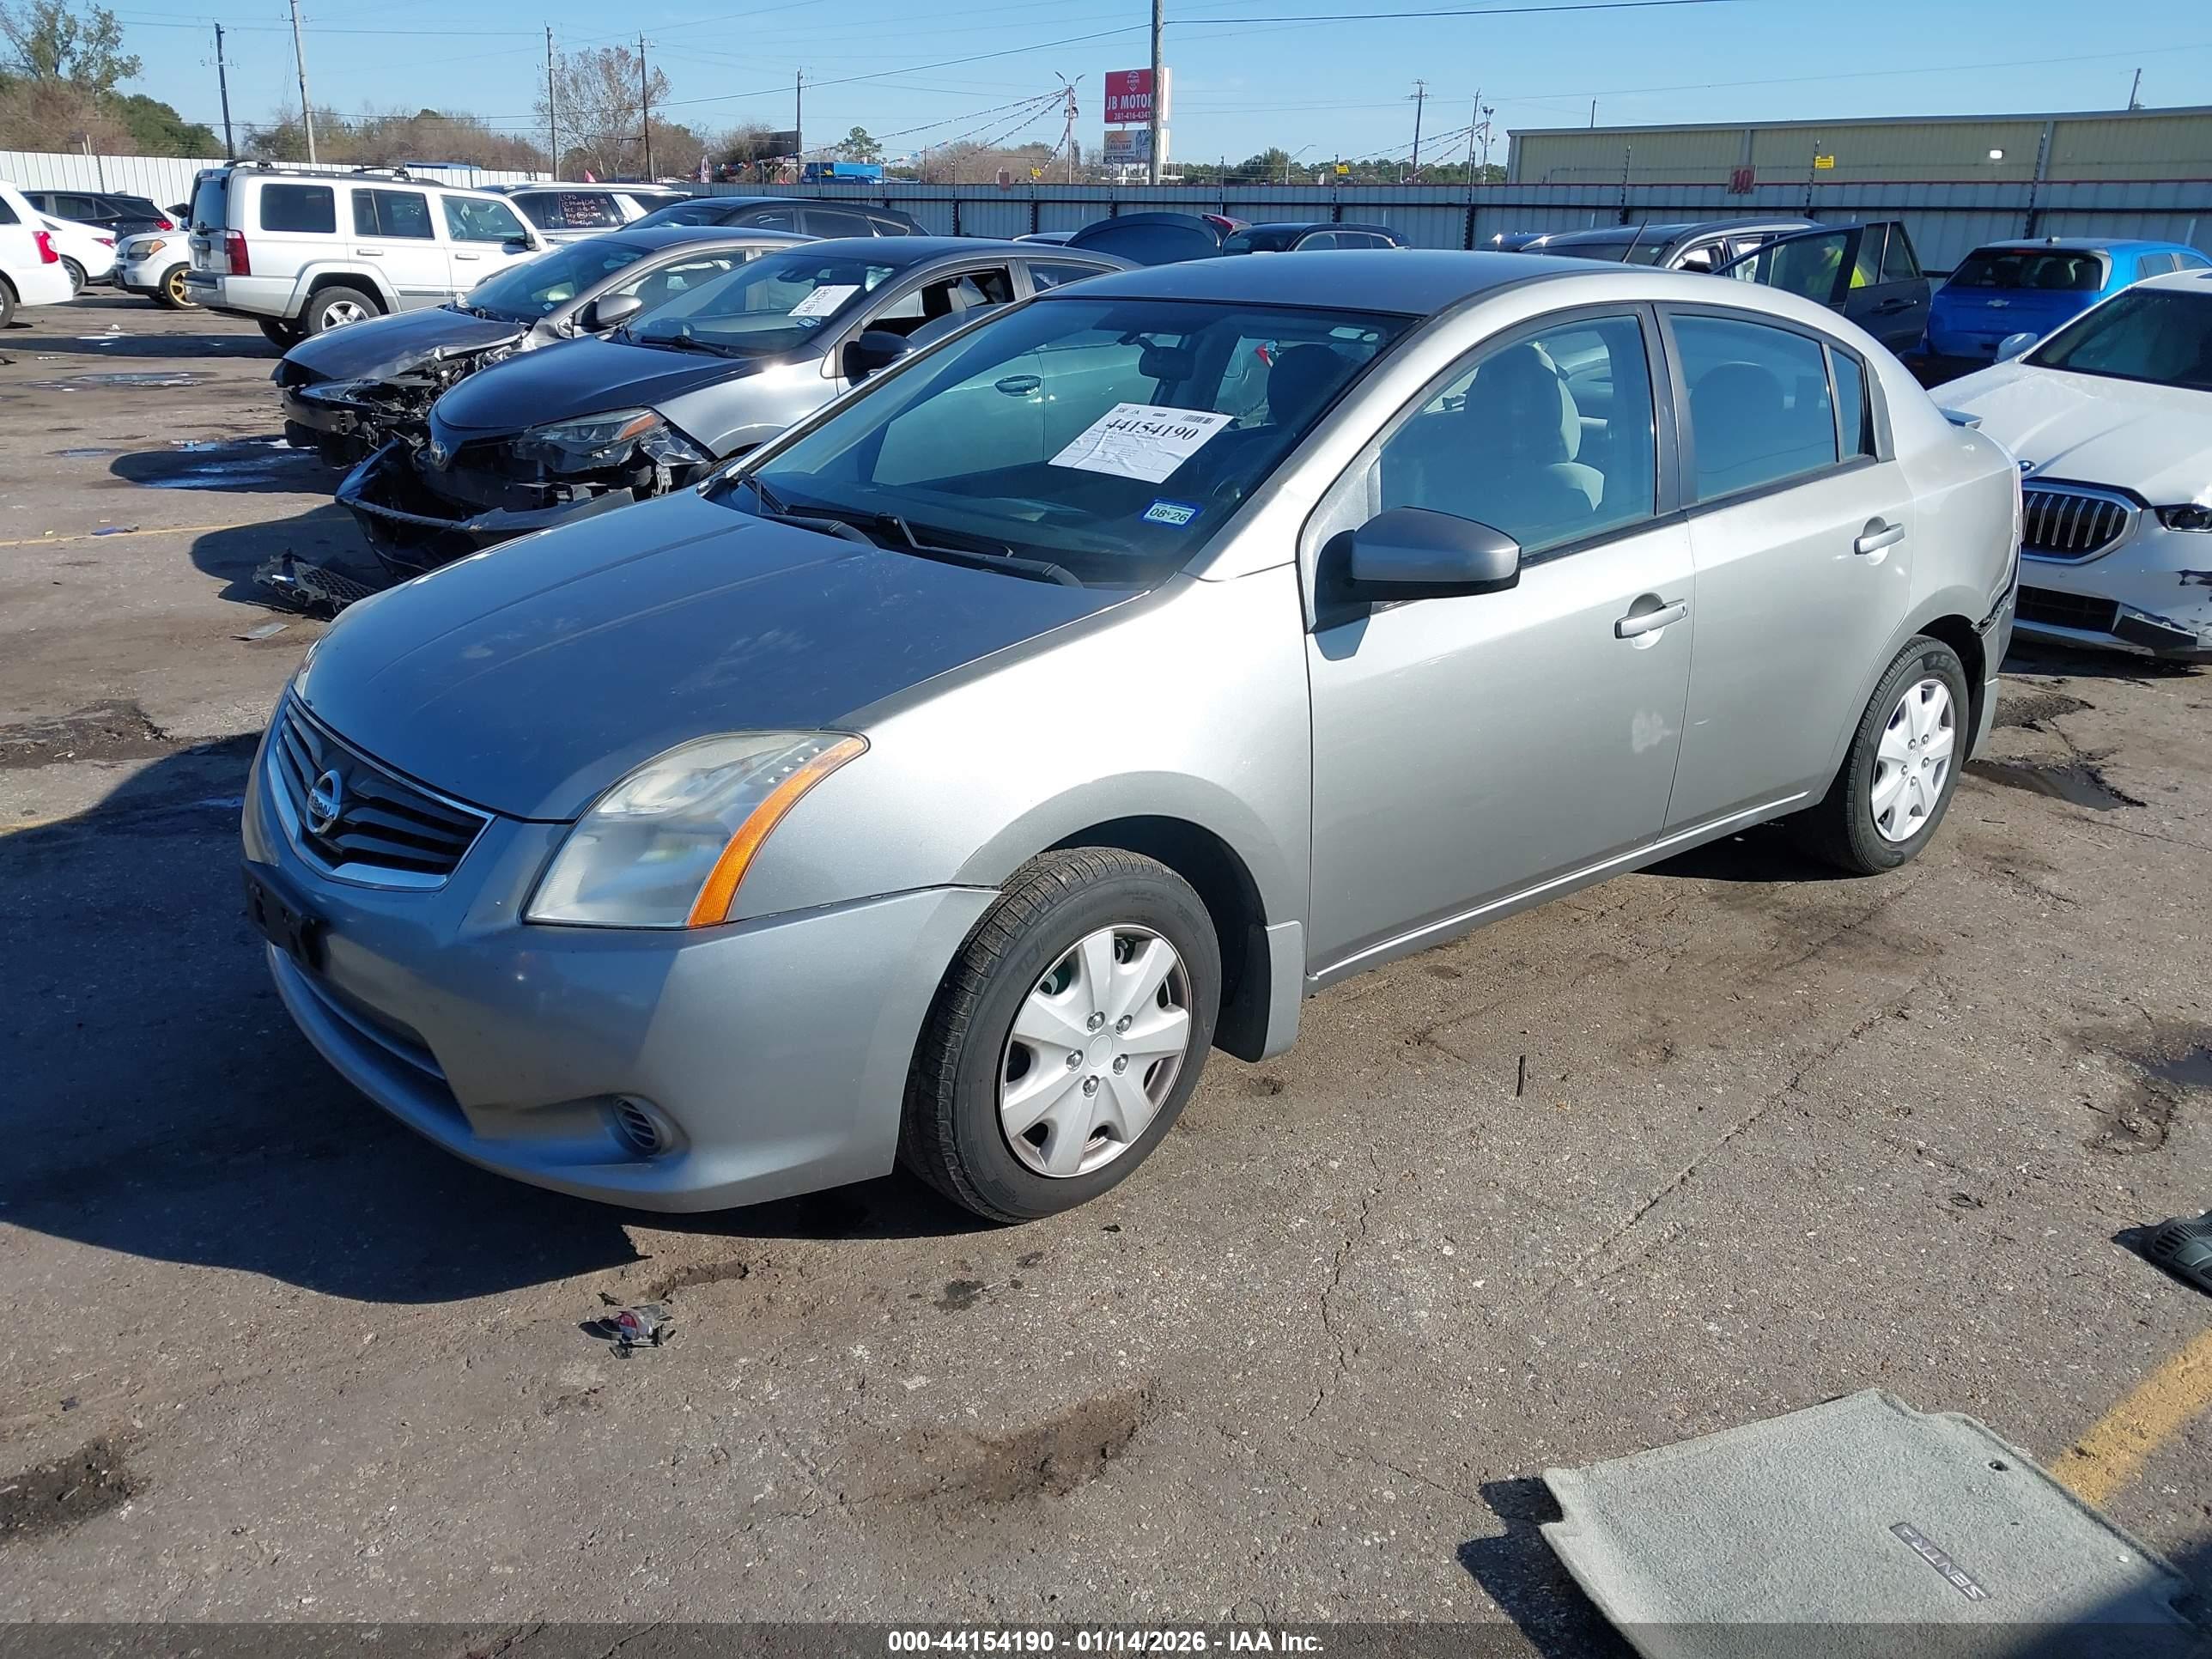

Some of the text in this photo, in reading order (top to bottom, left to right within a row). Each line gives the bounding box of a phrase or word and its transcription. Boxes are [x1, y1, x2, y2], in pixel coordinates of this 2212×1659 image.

[1107, 95, 1118, 110] JB
[1106, 418, 1199, 441] 44154190
[1150, 508, 1189, 522] 08 26
[1902, 1526, 1986, 1599] SENTRA
